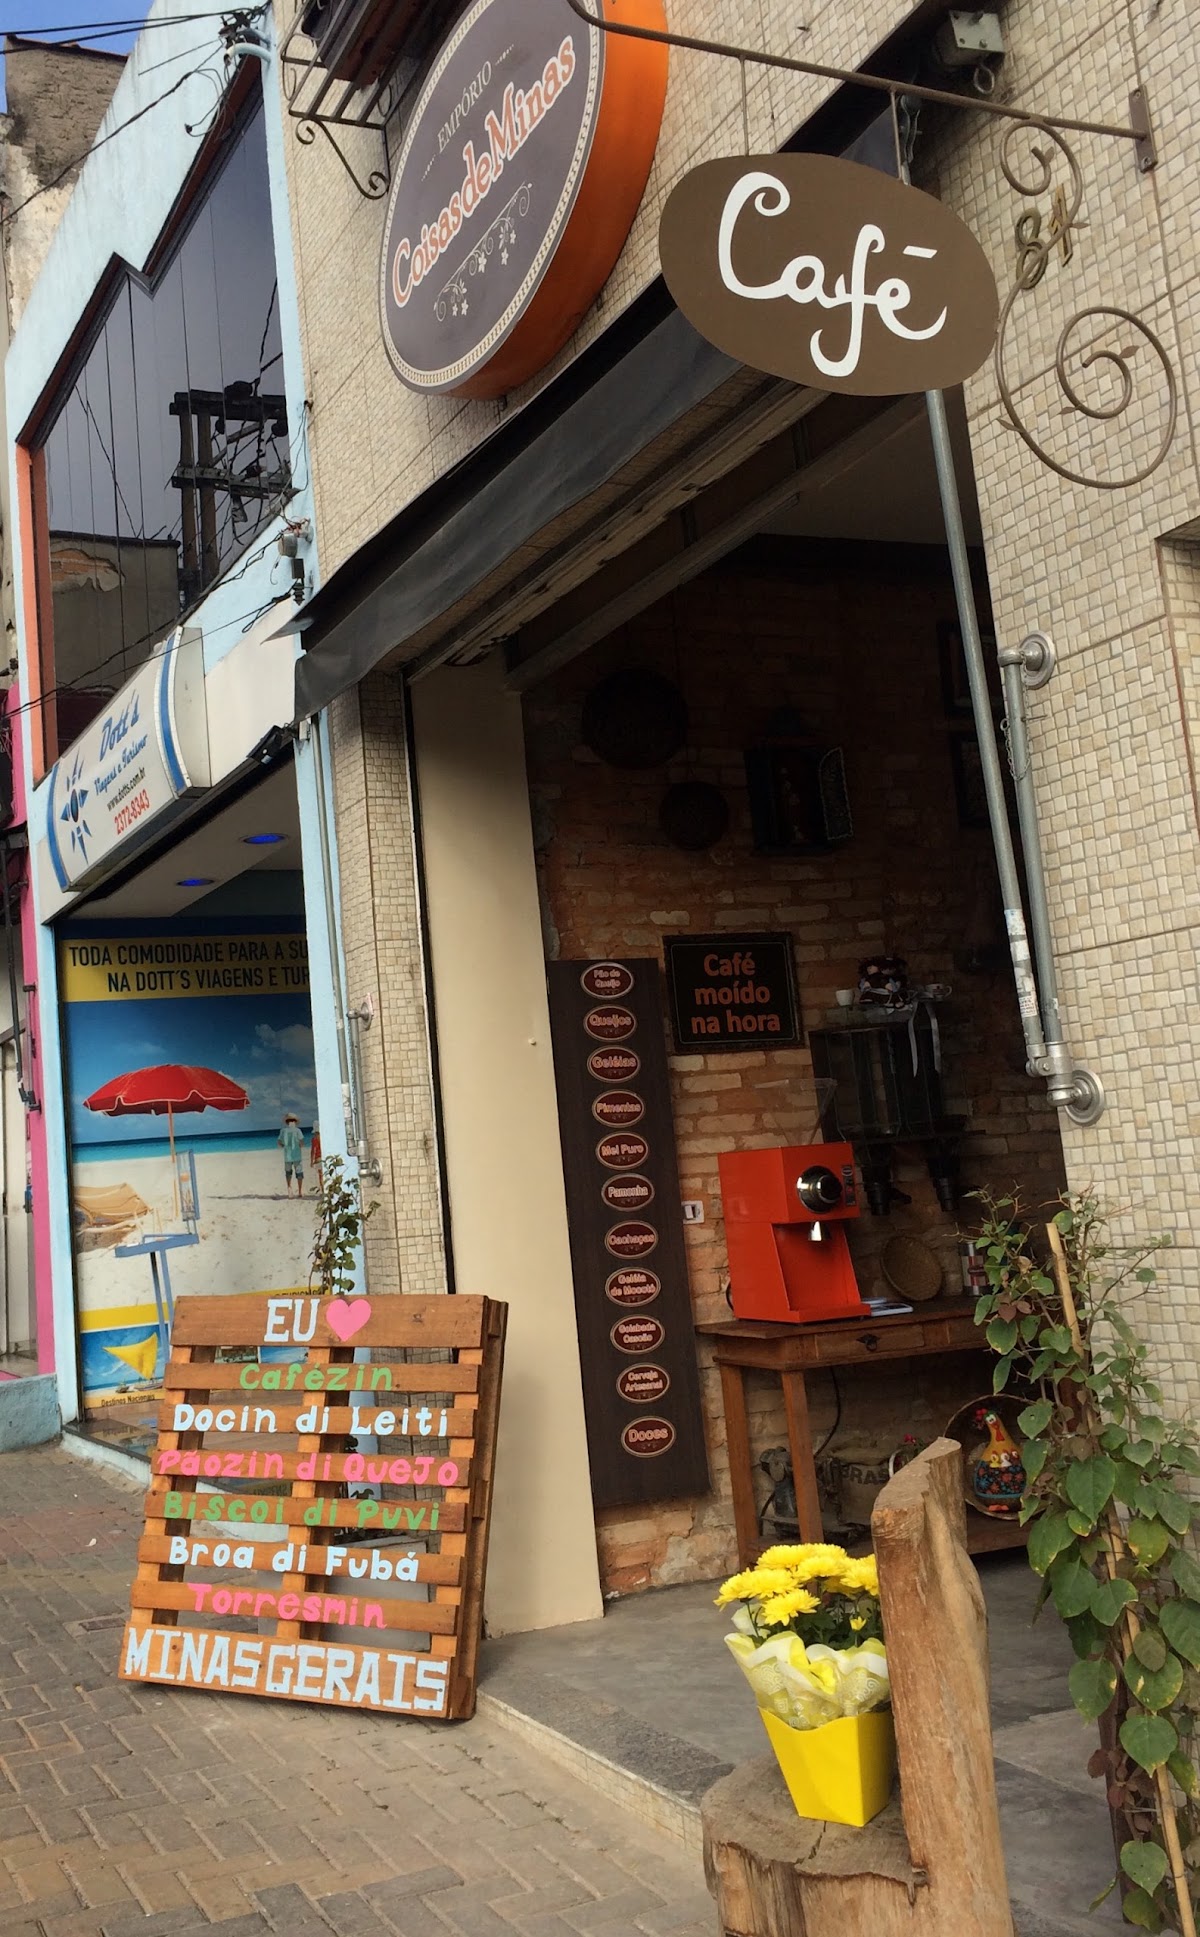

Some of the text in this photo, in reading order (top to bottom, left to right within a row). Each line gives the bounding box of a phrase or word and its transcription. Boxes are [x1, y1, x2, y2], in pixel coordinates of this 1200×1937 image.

[437, 61, 493, 153] EMPÓRIO
[718, 171, 948, 378] Café
[106, 766, 146, 812] www.dotts.com.br
[114, 788, 151, 836] 2372-8343
[69, 945, 113, 967] TODA
[117, 942, 225, 965] COMODIDADE
[229, 941, 269, 962] PARA
[274, 941, 285, 961] A
[703, 951, 756, 977] Café
[108, 972, 132, 993] NA
[196, 967, 264, 989] VIAGENS
[269, 967, 279, 987] E
[694, 980, 771, 1006] moído
[589, 1013, 633, 1029] Queijos
[691, 1009, 781, 1035] na hora
[596, 1101, 642, 1115] Pimentas
[601, 1142, 645, 1157] Mel Puro
[608, 1184, 649, 1199] Pamonha
[264, 1298, 320, 1342] EU
[240, 1363, 393, 1391] Cafézin
[173, 1403, 278, 1432] Docin
[296, 1405, 330, 1434] di
[350, 1406, 448, 1437] Leiti
[628, 1426, 669, 1443] Doces
[157, 1450, 284, 1479] Pãozin
[296, 1452, 332, 1481] di
[163, 1491, 440, 1531] Biscoi di Puvi
[168, 1536, 420, 1582] Broa di Fubá
[187, 1583, 387, 1630] Torresmin
